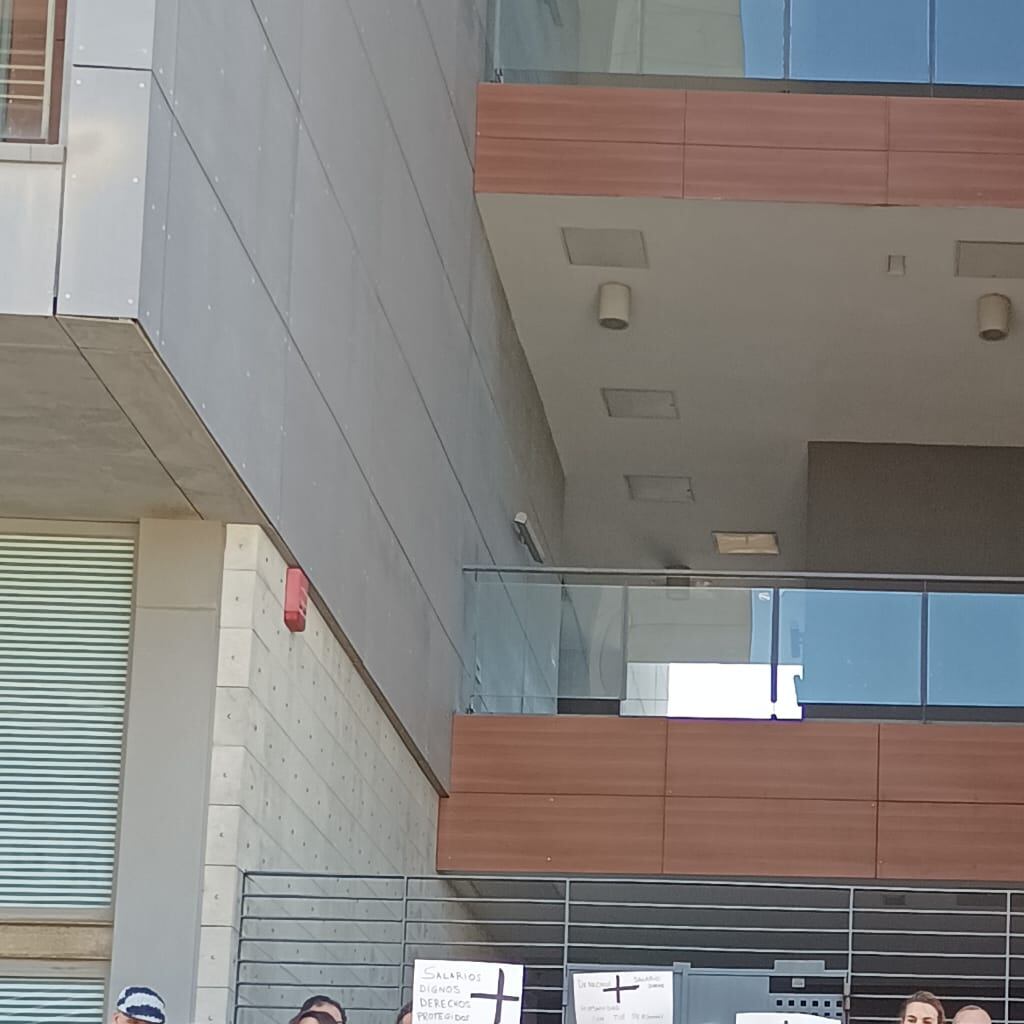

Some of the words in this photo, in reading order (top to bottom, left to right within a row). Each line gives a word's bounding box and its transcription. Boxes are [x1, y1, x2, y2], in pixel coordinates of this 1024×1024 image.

[421, 966, 481, 981] SALARIOS
[420, 985, 460, 994] DIGNOS
[420, 998, 471, 1008] DERECHOS
[417, 1011, 470, 1021] PROTEGIDOS
